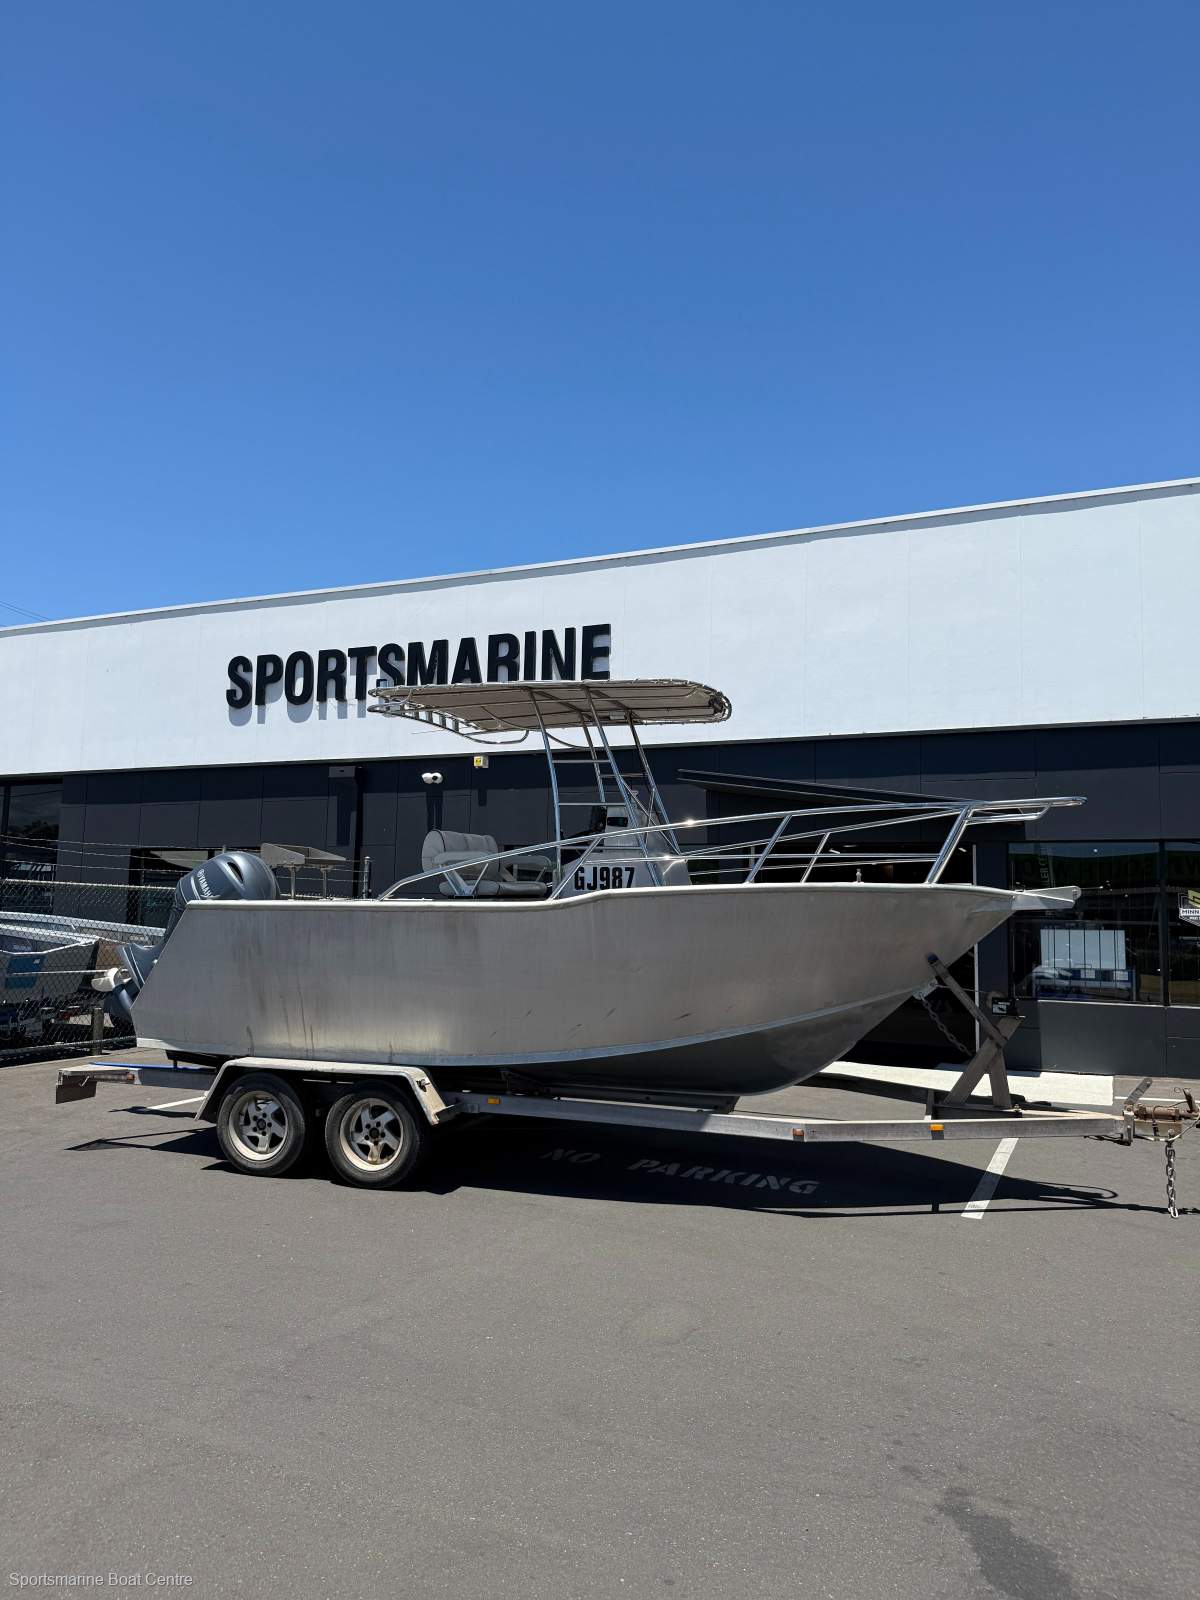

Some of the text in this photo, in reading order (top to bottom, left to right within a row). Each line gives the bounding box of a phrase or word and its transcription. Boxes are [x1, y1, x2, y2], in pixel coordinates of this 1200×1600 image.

[226, 623, 612, 709] SPORTSMARINE
[198, 873, 213, 897] YAMAH
[574, 866, 635, 890] GJ987
[539, 1147, 820, 1194] NO PARKING
